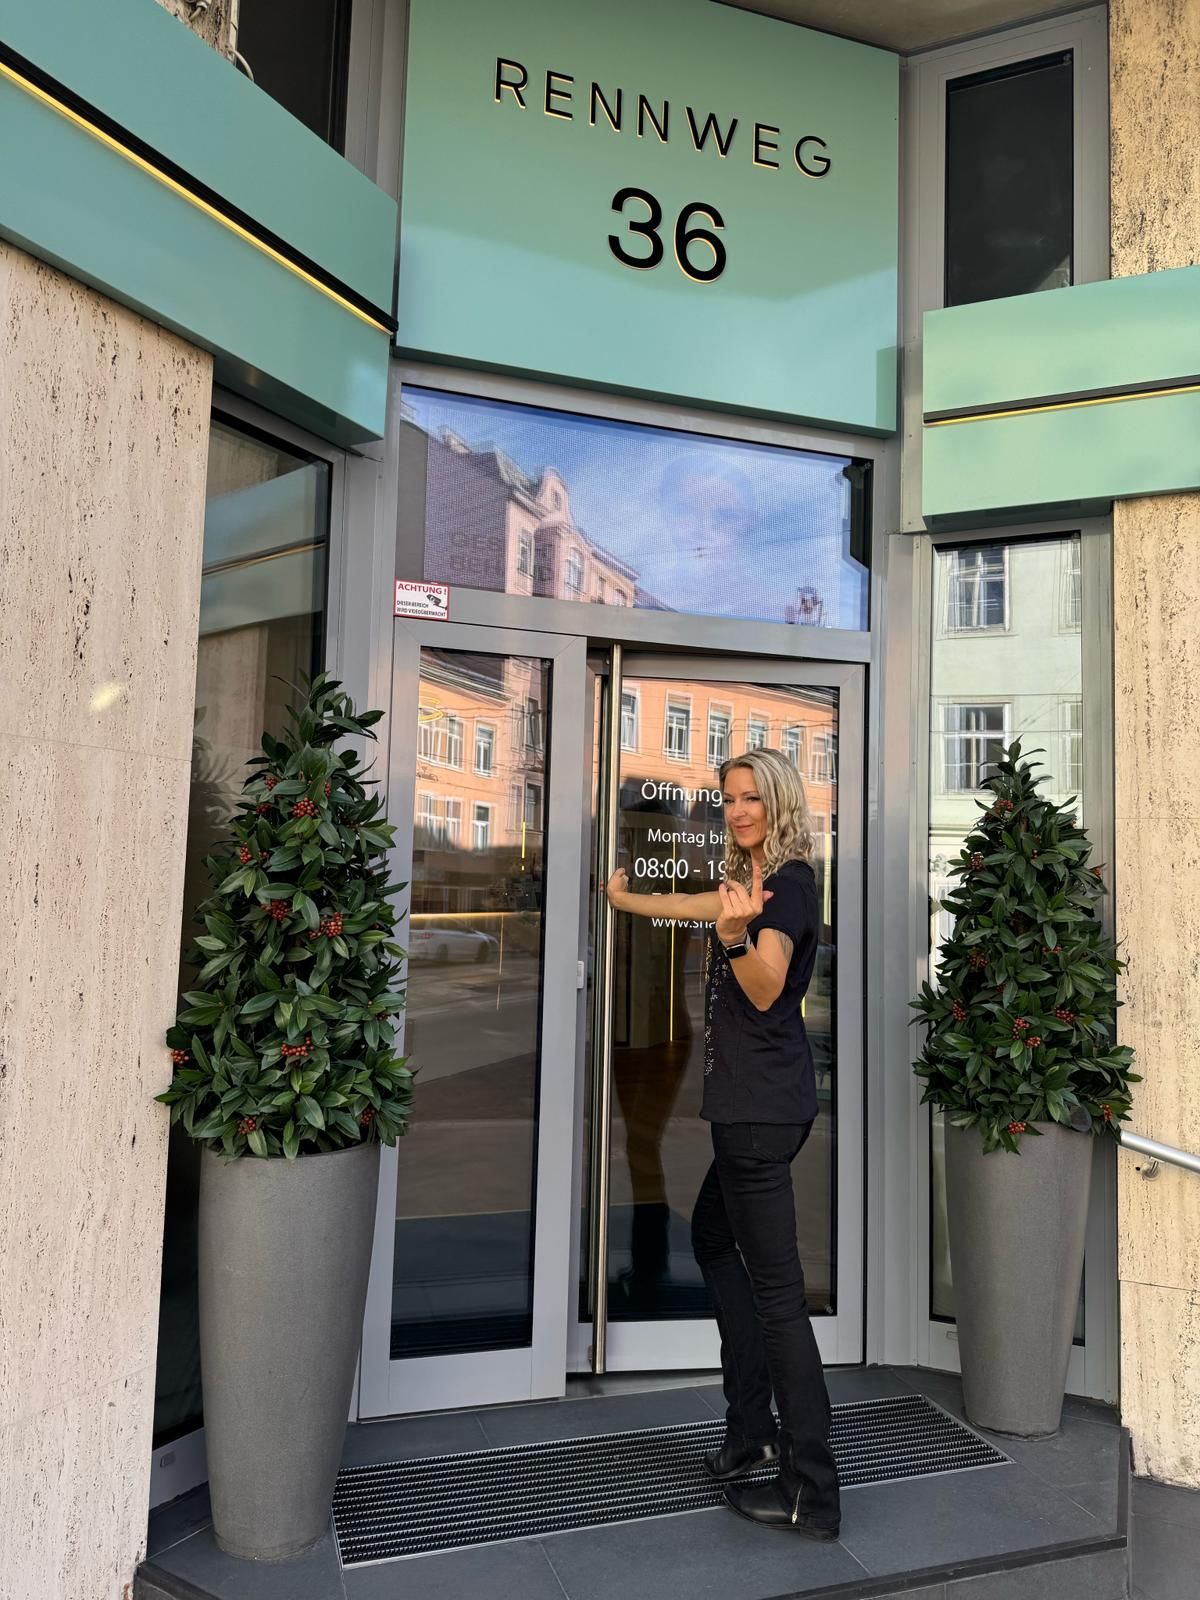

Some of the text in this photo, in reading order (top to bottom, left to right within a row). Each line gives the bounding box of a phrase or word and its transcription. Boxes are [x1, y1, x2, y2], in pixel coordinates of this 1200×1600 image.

[494, 56, 832, 179] RENNWEG
[607, 186, 727, 283] 36
[641, 778, 723, 807] Öffnung
[647, 828, 705, 848] Montag
[634, 857, 689, 880] 08:00
